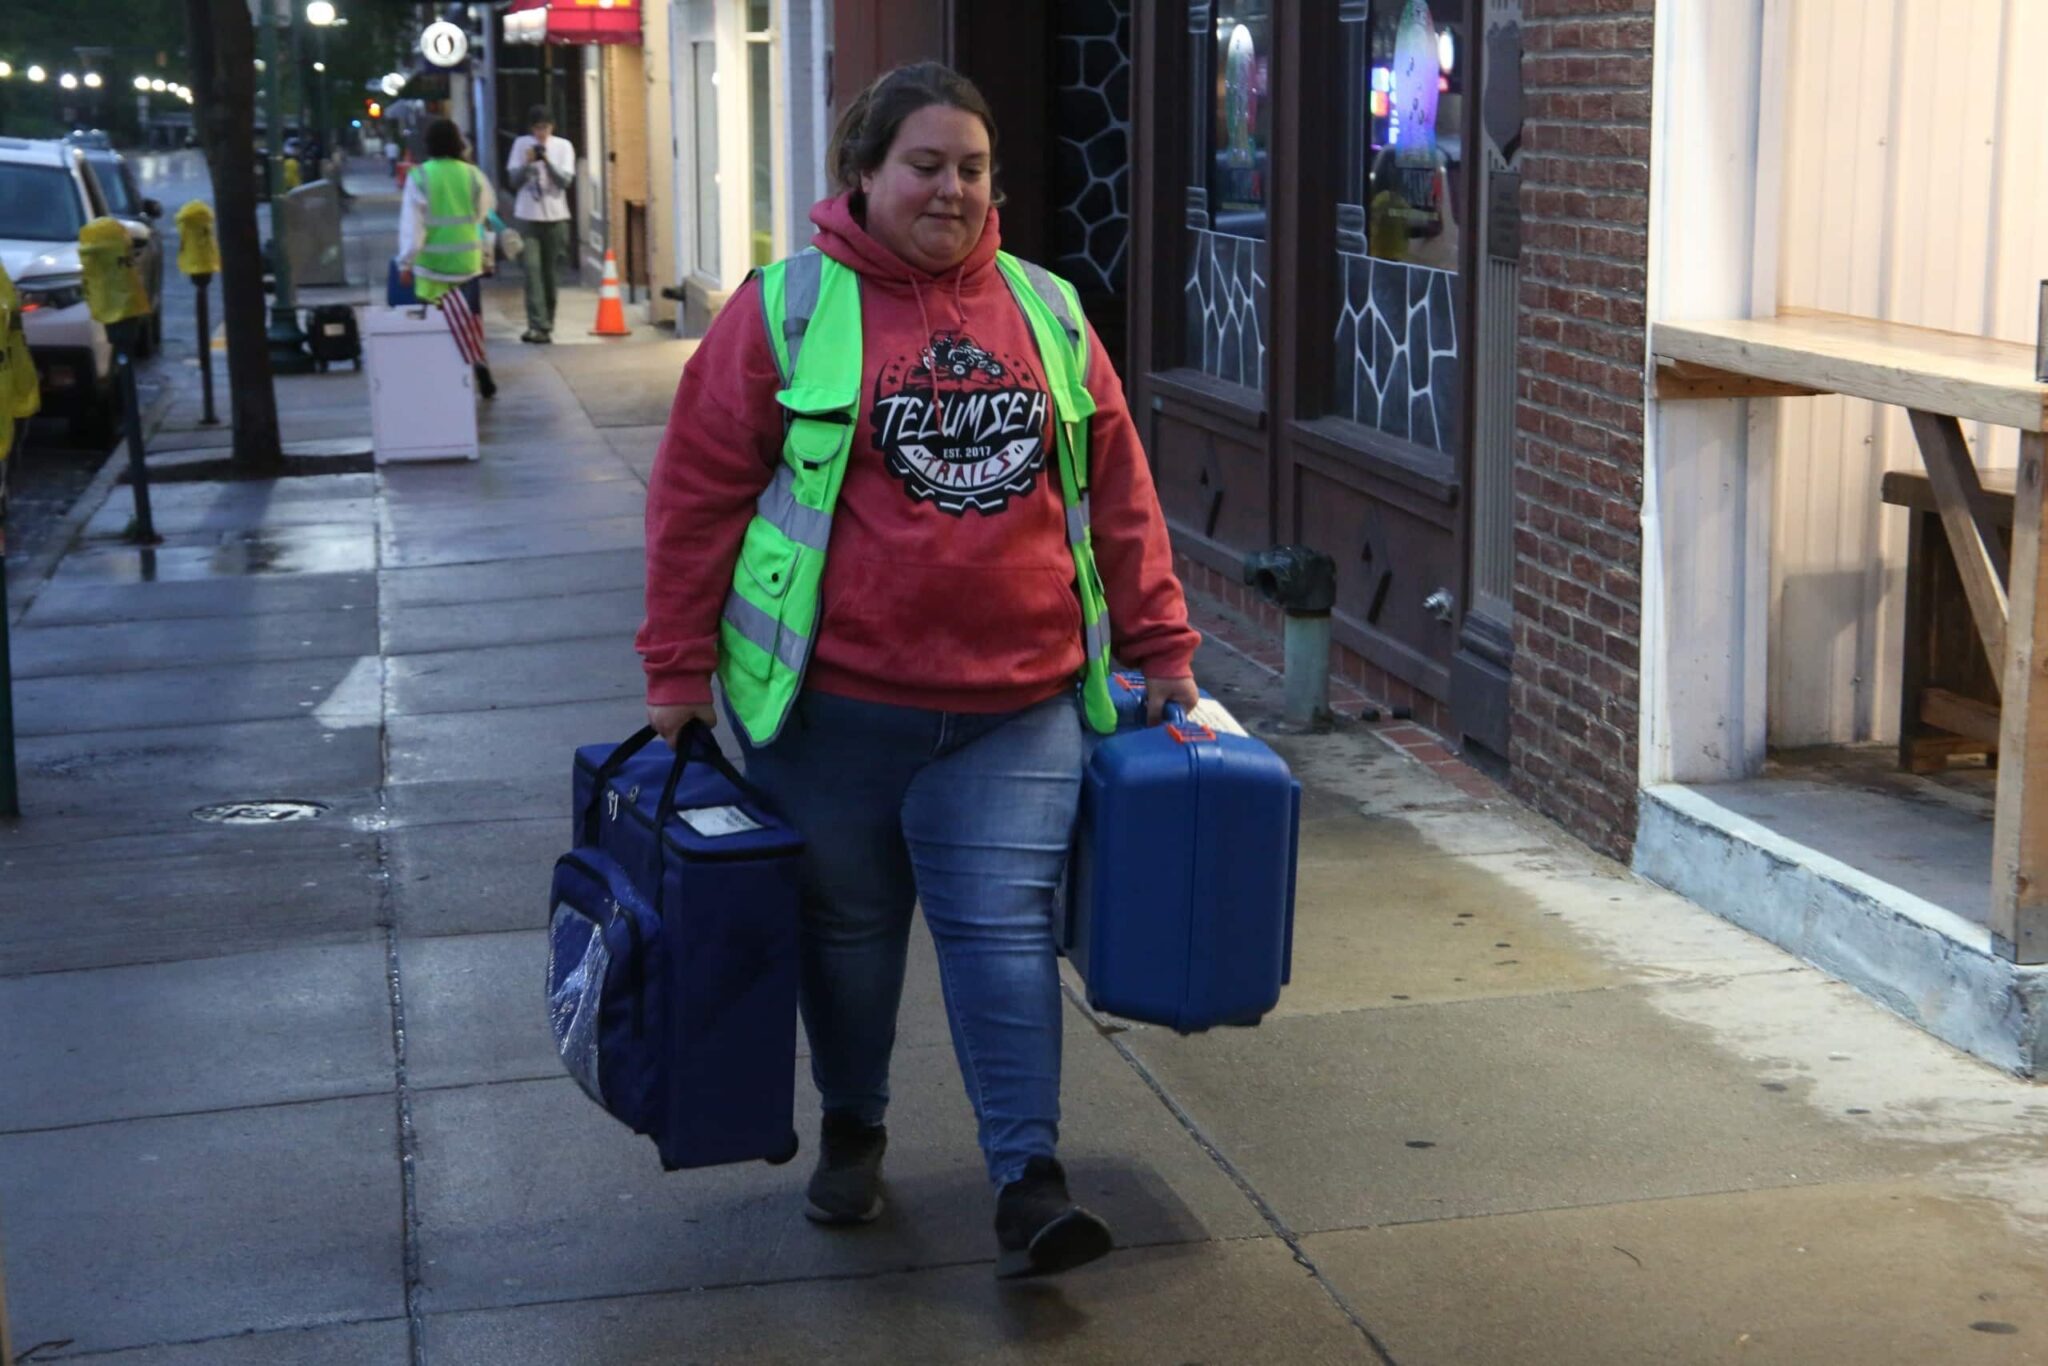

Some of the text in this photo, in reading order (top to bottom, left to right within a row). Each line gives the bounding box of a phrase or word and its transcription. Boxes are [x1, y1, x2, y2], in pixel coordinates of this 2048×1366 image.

[876, 391, 1047, 446] TECUMSEH
[922, 450, 1012, 487] TRAILS
[943, 446, 991, 459] EST. 2017
